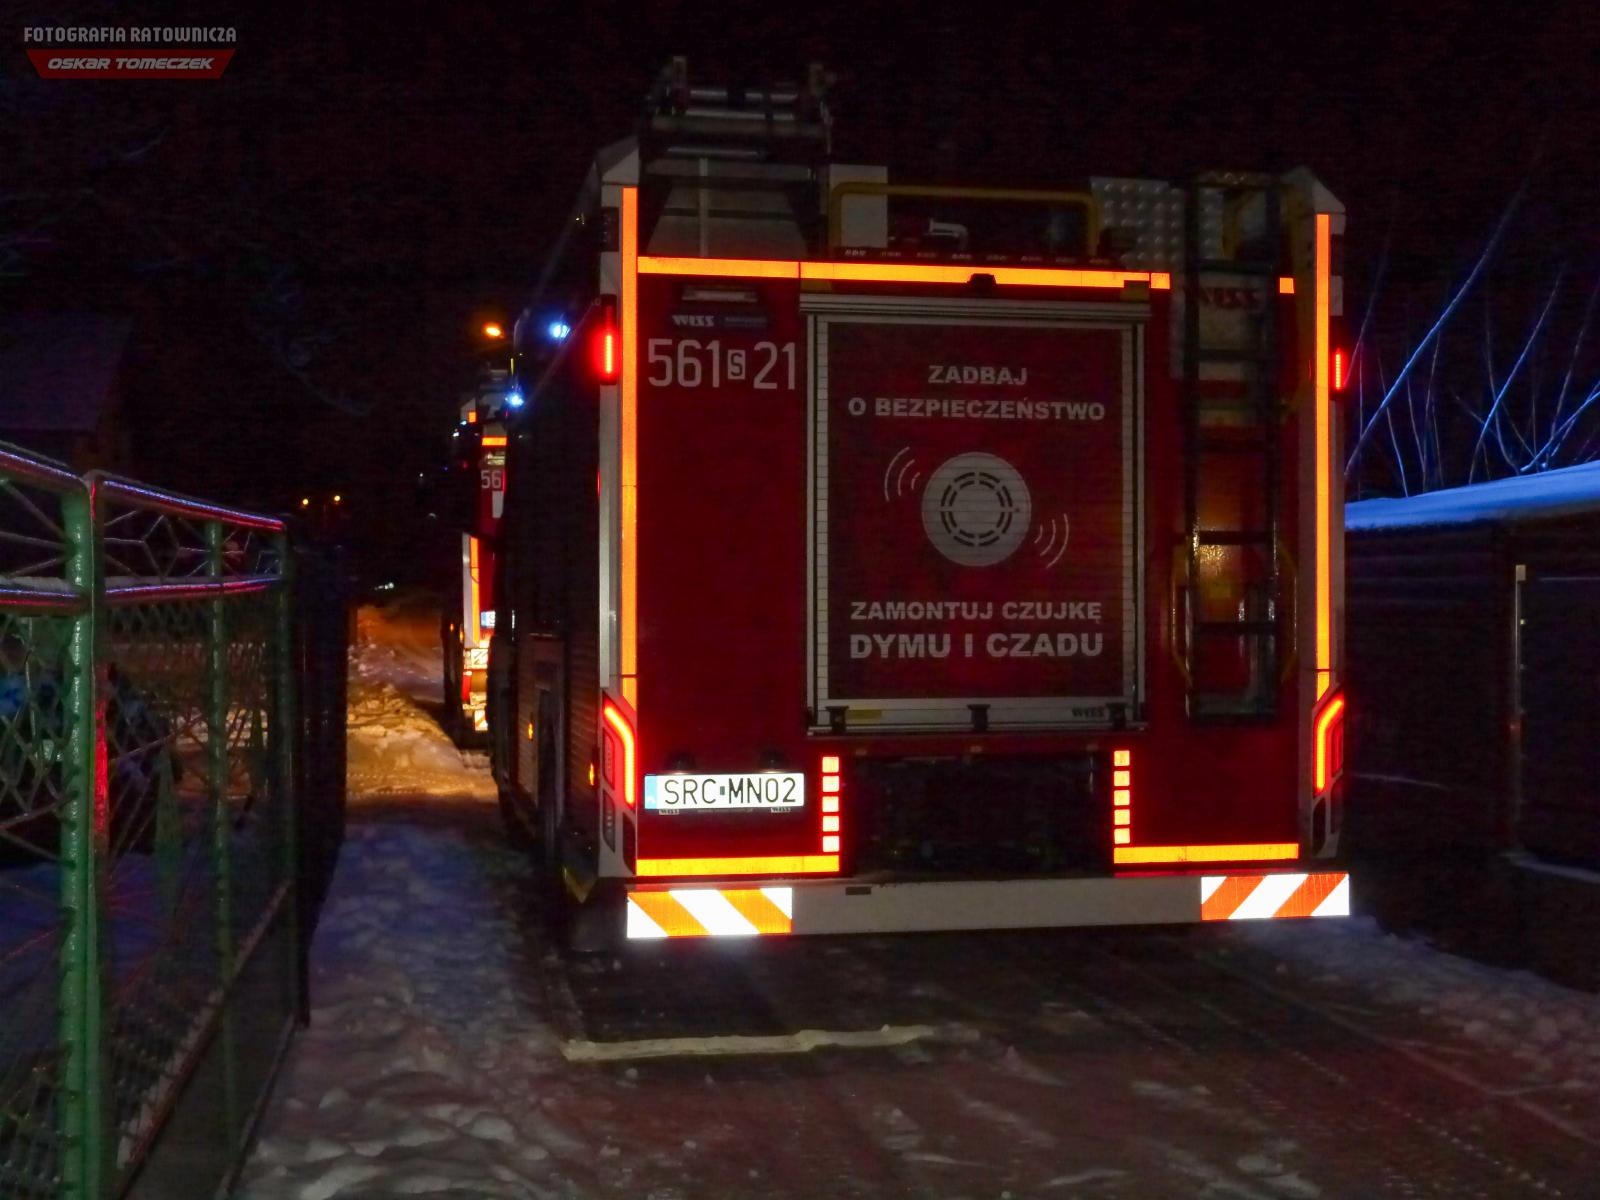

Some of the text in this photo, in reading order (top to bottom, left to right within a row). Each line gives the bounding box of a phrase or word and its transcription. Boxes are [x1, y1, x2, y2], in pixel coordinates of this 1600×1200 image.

[647, 338, 720, 388] 561
[753, 341, 796, 390] 21
[927, 365, 1028, 385] ZADBAJ
[849, 397, 1105, 421] O BEZPIECZEŃSTWO
[851, 601, 1102, 624] ZAMONTUJ CZUJKĘ
[850, 633, 1104, 659] DYMU I CZADU
[664, 777, 797, 805] SRC MN02
